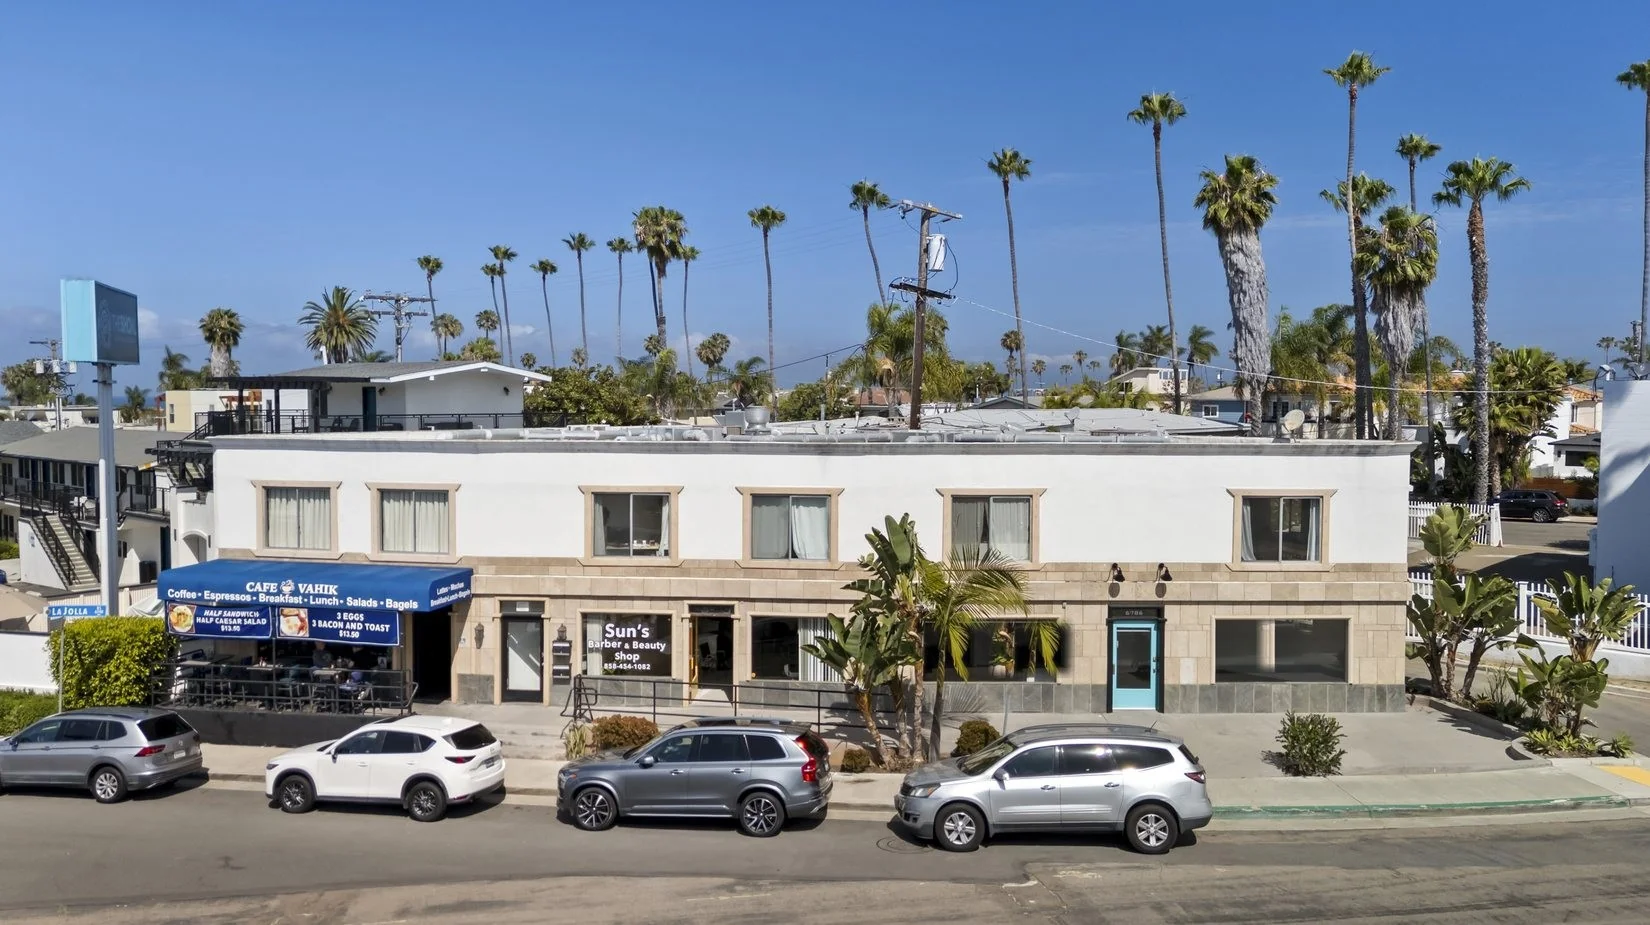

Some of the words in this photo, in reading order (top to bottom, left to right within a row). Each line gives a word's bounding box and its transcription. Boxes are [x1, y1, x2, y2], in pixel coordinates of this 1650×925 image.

[246, 582, 278, 592] CAFE
[297, 583, 338, 595] VAHIK
[167, 589, 197, 599] Coffee
[203, 590, 251, 602] Espressos
[258, 592, 303, 604] Breakfast
[310, 596, 339, 606] Lunch
[346, 597, 378, 608] Salads
[385, 599, 419, 610] Bagels
[63, 606, 88, 615] JOLLA
[203, 609, 223, 617] HALF
[223, 610, 260, 618] SANDWICH
[214, 617, 242, 625] CAESAR
[336, 612, 341, 620] 3
[342, 612, 364, 621] EGGS
[317, 620, 343, 629] BACON
[345, 622, 363, 630] AND
[365, 623, 391, 632] TOAST
[605, 623, 650, 638] Sun's
[338, 630, 360, 638] $13.50
[588, 639, 622, 648] Barber
[632, 641, 666, 652] Beauty
[614, 651, 640, 662] Shop
